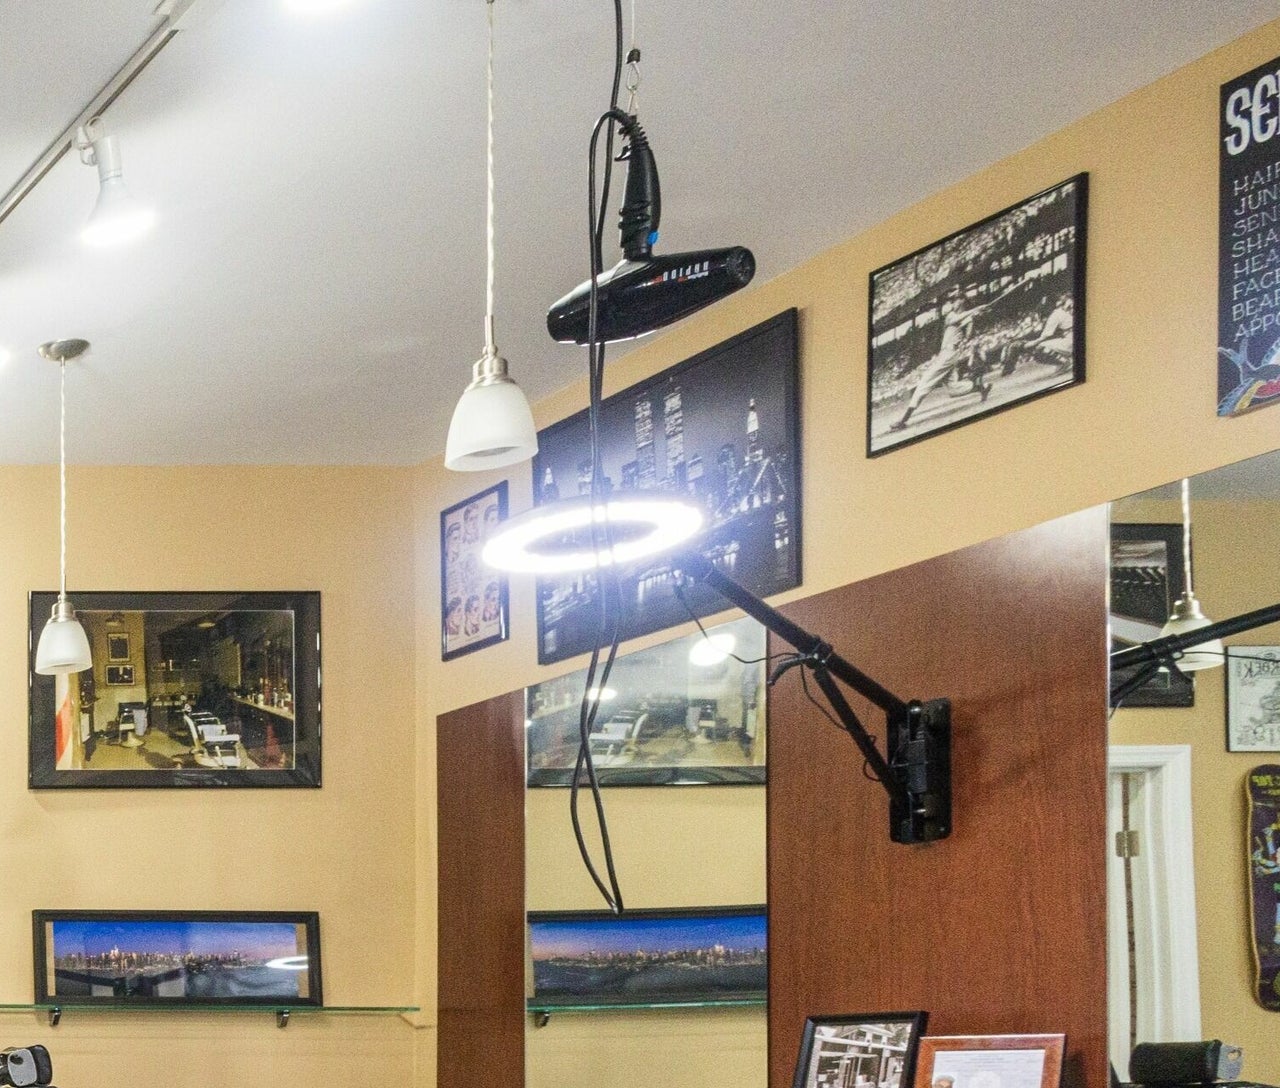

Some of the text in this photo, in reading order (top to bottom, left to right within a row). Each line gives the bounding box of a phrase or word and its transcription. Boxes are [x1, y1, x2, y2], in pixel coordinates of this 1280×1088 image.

[1224, 70, 1280, 155] SE
[1234, 184, 1280, 215] JUN
[1232, 205, 1280, 237] SEN
[1232, 228, 1280, 258] SHA
[1233, 249, 1280, 279] HEA
